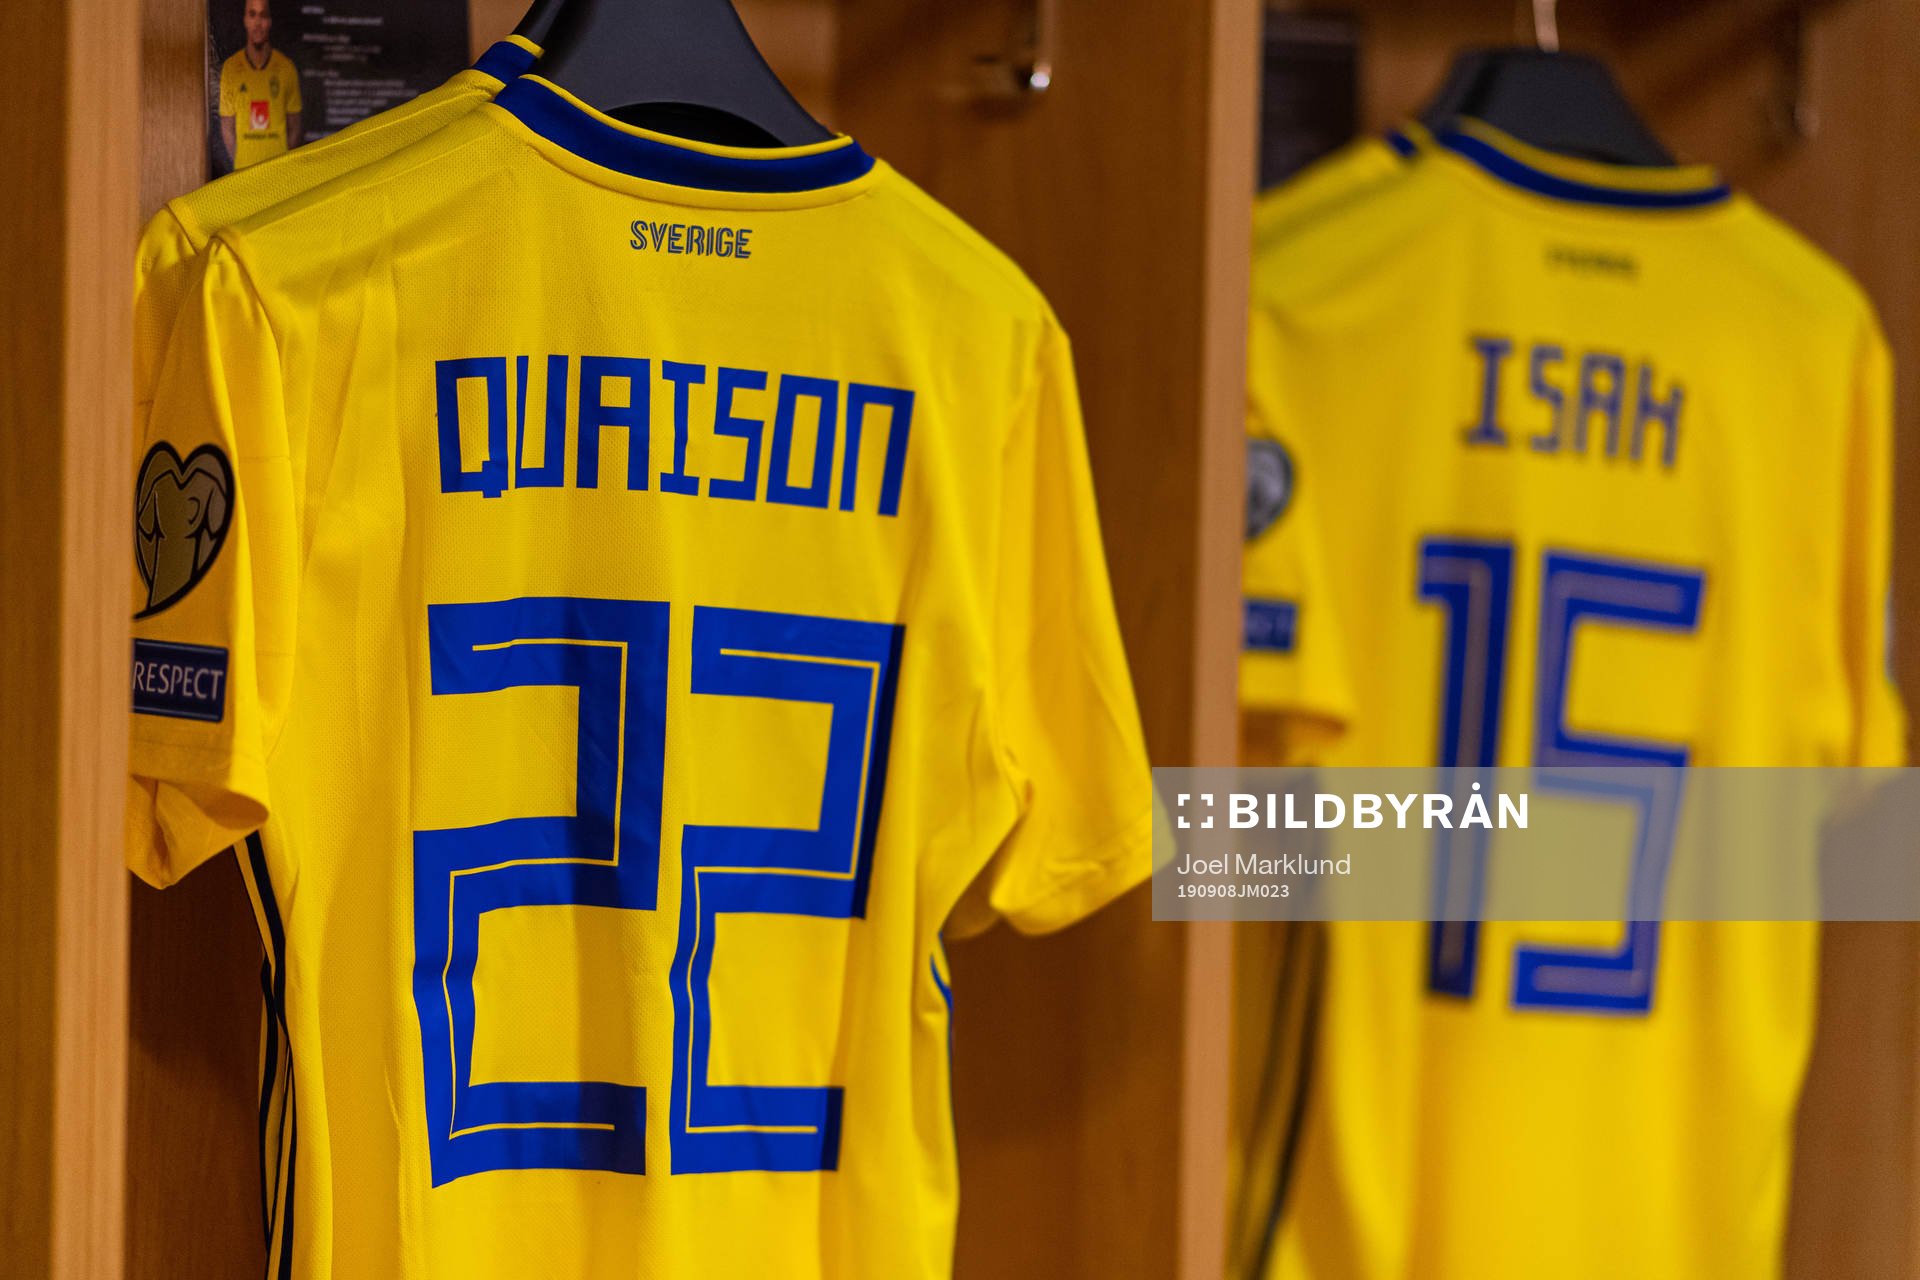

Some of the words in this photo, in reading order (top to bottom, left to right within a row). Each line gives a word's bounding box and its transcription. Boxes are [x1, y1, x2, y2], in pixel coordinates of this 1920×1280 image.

[630, 220, 753, 259] SVERIGE
[435, 354, 916, 517] QUAISON
[133, 661, 224, 700] RESPECT
[1416, 535, 1706, 1015] 15
[413, 596, 906, 1188] 22
